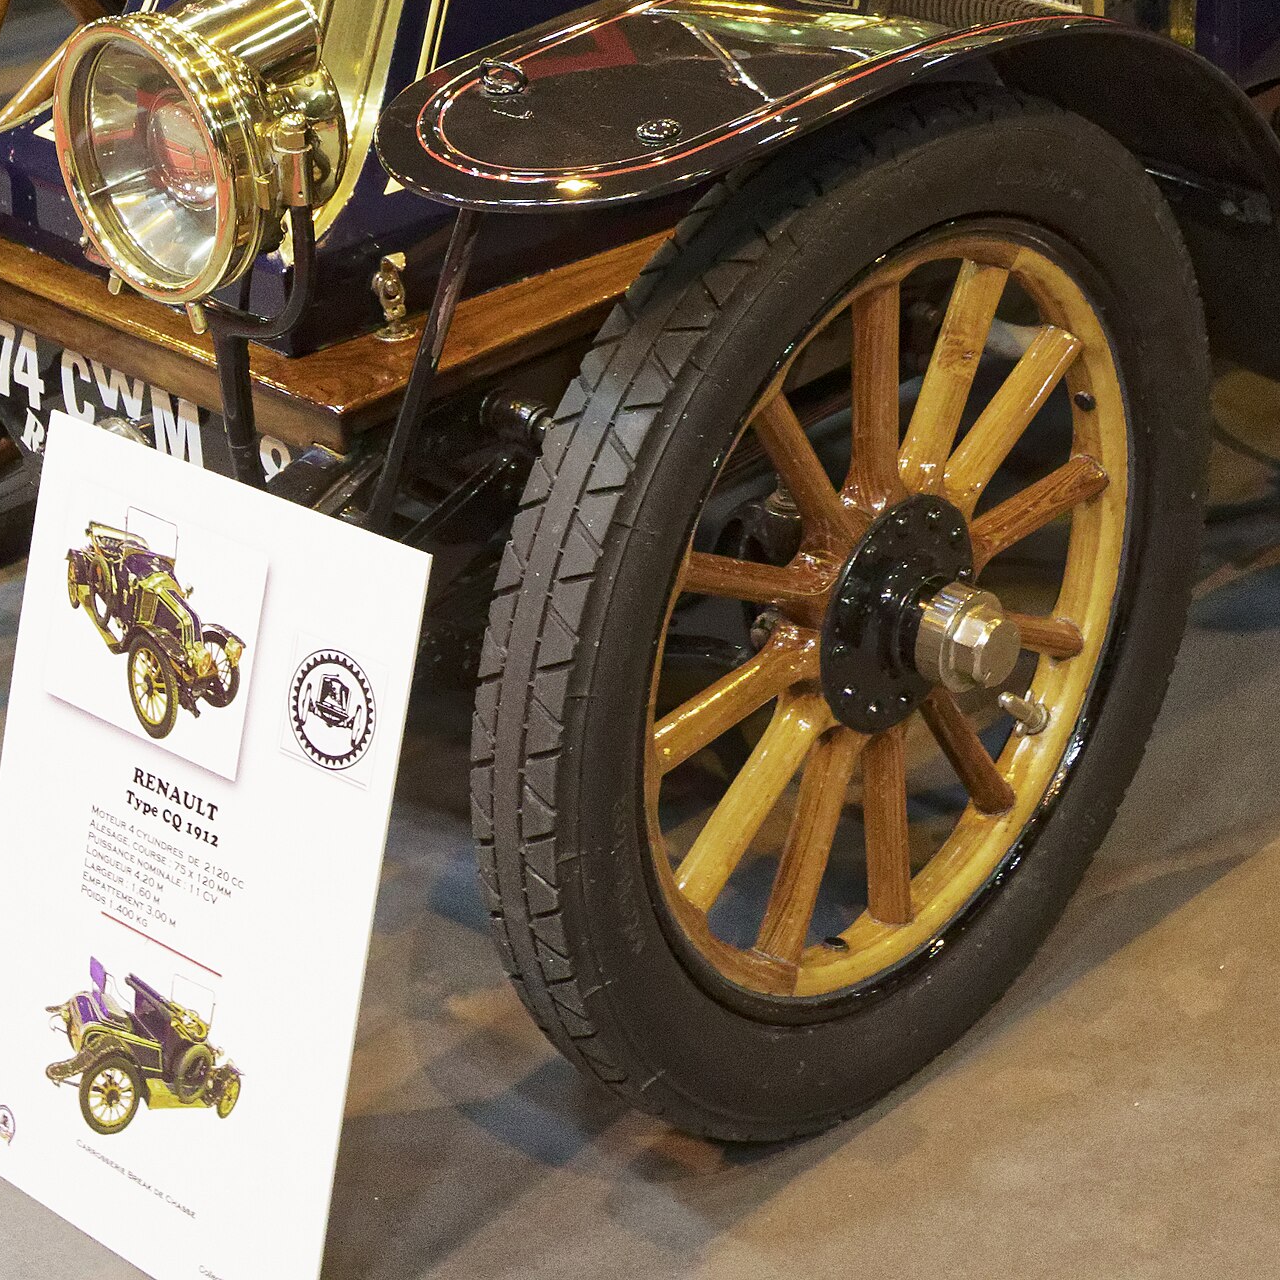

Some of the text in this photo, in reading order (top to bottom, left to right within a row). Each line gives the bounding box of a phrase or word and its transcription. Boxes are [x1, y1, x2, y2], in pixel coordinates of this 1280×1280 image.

[61, 349, 204, 469] CWM
[133, 767, 218, 821] RENAULT
[126, 790, 218, 848] Type CQ 1912
[84, 857, 124, 885] LARGEUR
[86, 844, 132, 874] LONGUEUR
[88, 831, 135, 864] PUISSANCE
[136, 859, 181, 888] NOMINALE
[202, 891, 218, 905] CV
[128, 825, 134, 834] 4
[136, 827, 184, 859] CYLINDRES
[187, 855, 200, 868] DE
[204, 862, 229, 882] 2120
[231, 877, 245, 890] CC
[174, 861, 186, 875] 75
[196, 873, 215, 890] 120
[80, 885, 106, 906] POIDS
[82, 871, 144, 911] EMPATTEMENT
